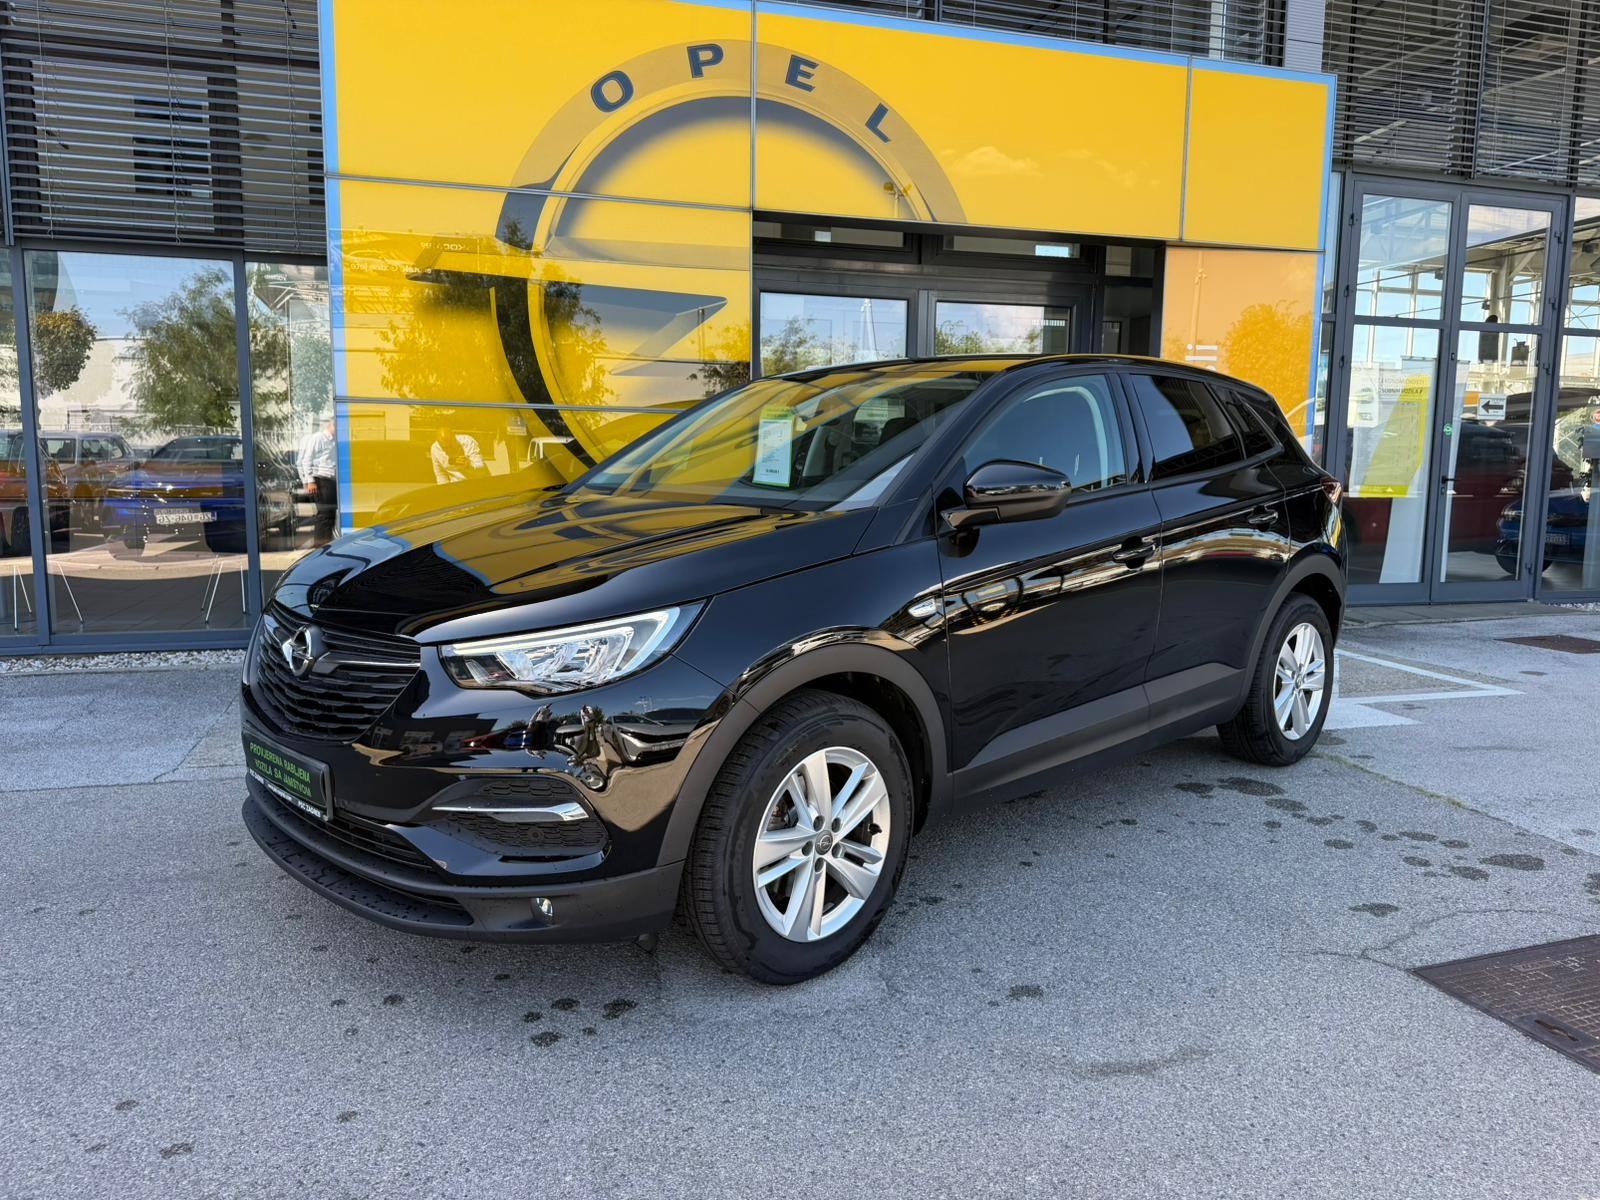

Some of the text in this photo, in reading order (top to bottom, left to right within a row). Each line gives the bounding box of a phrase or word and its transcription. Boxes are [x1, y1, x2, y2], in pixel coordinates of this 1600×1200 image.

[590, 43, 891, 143] OPEL
[250, 742, 311, 784] PROVJERENA RABLJENA
